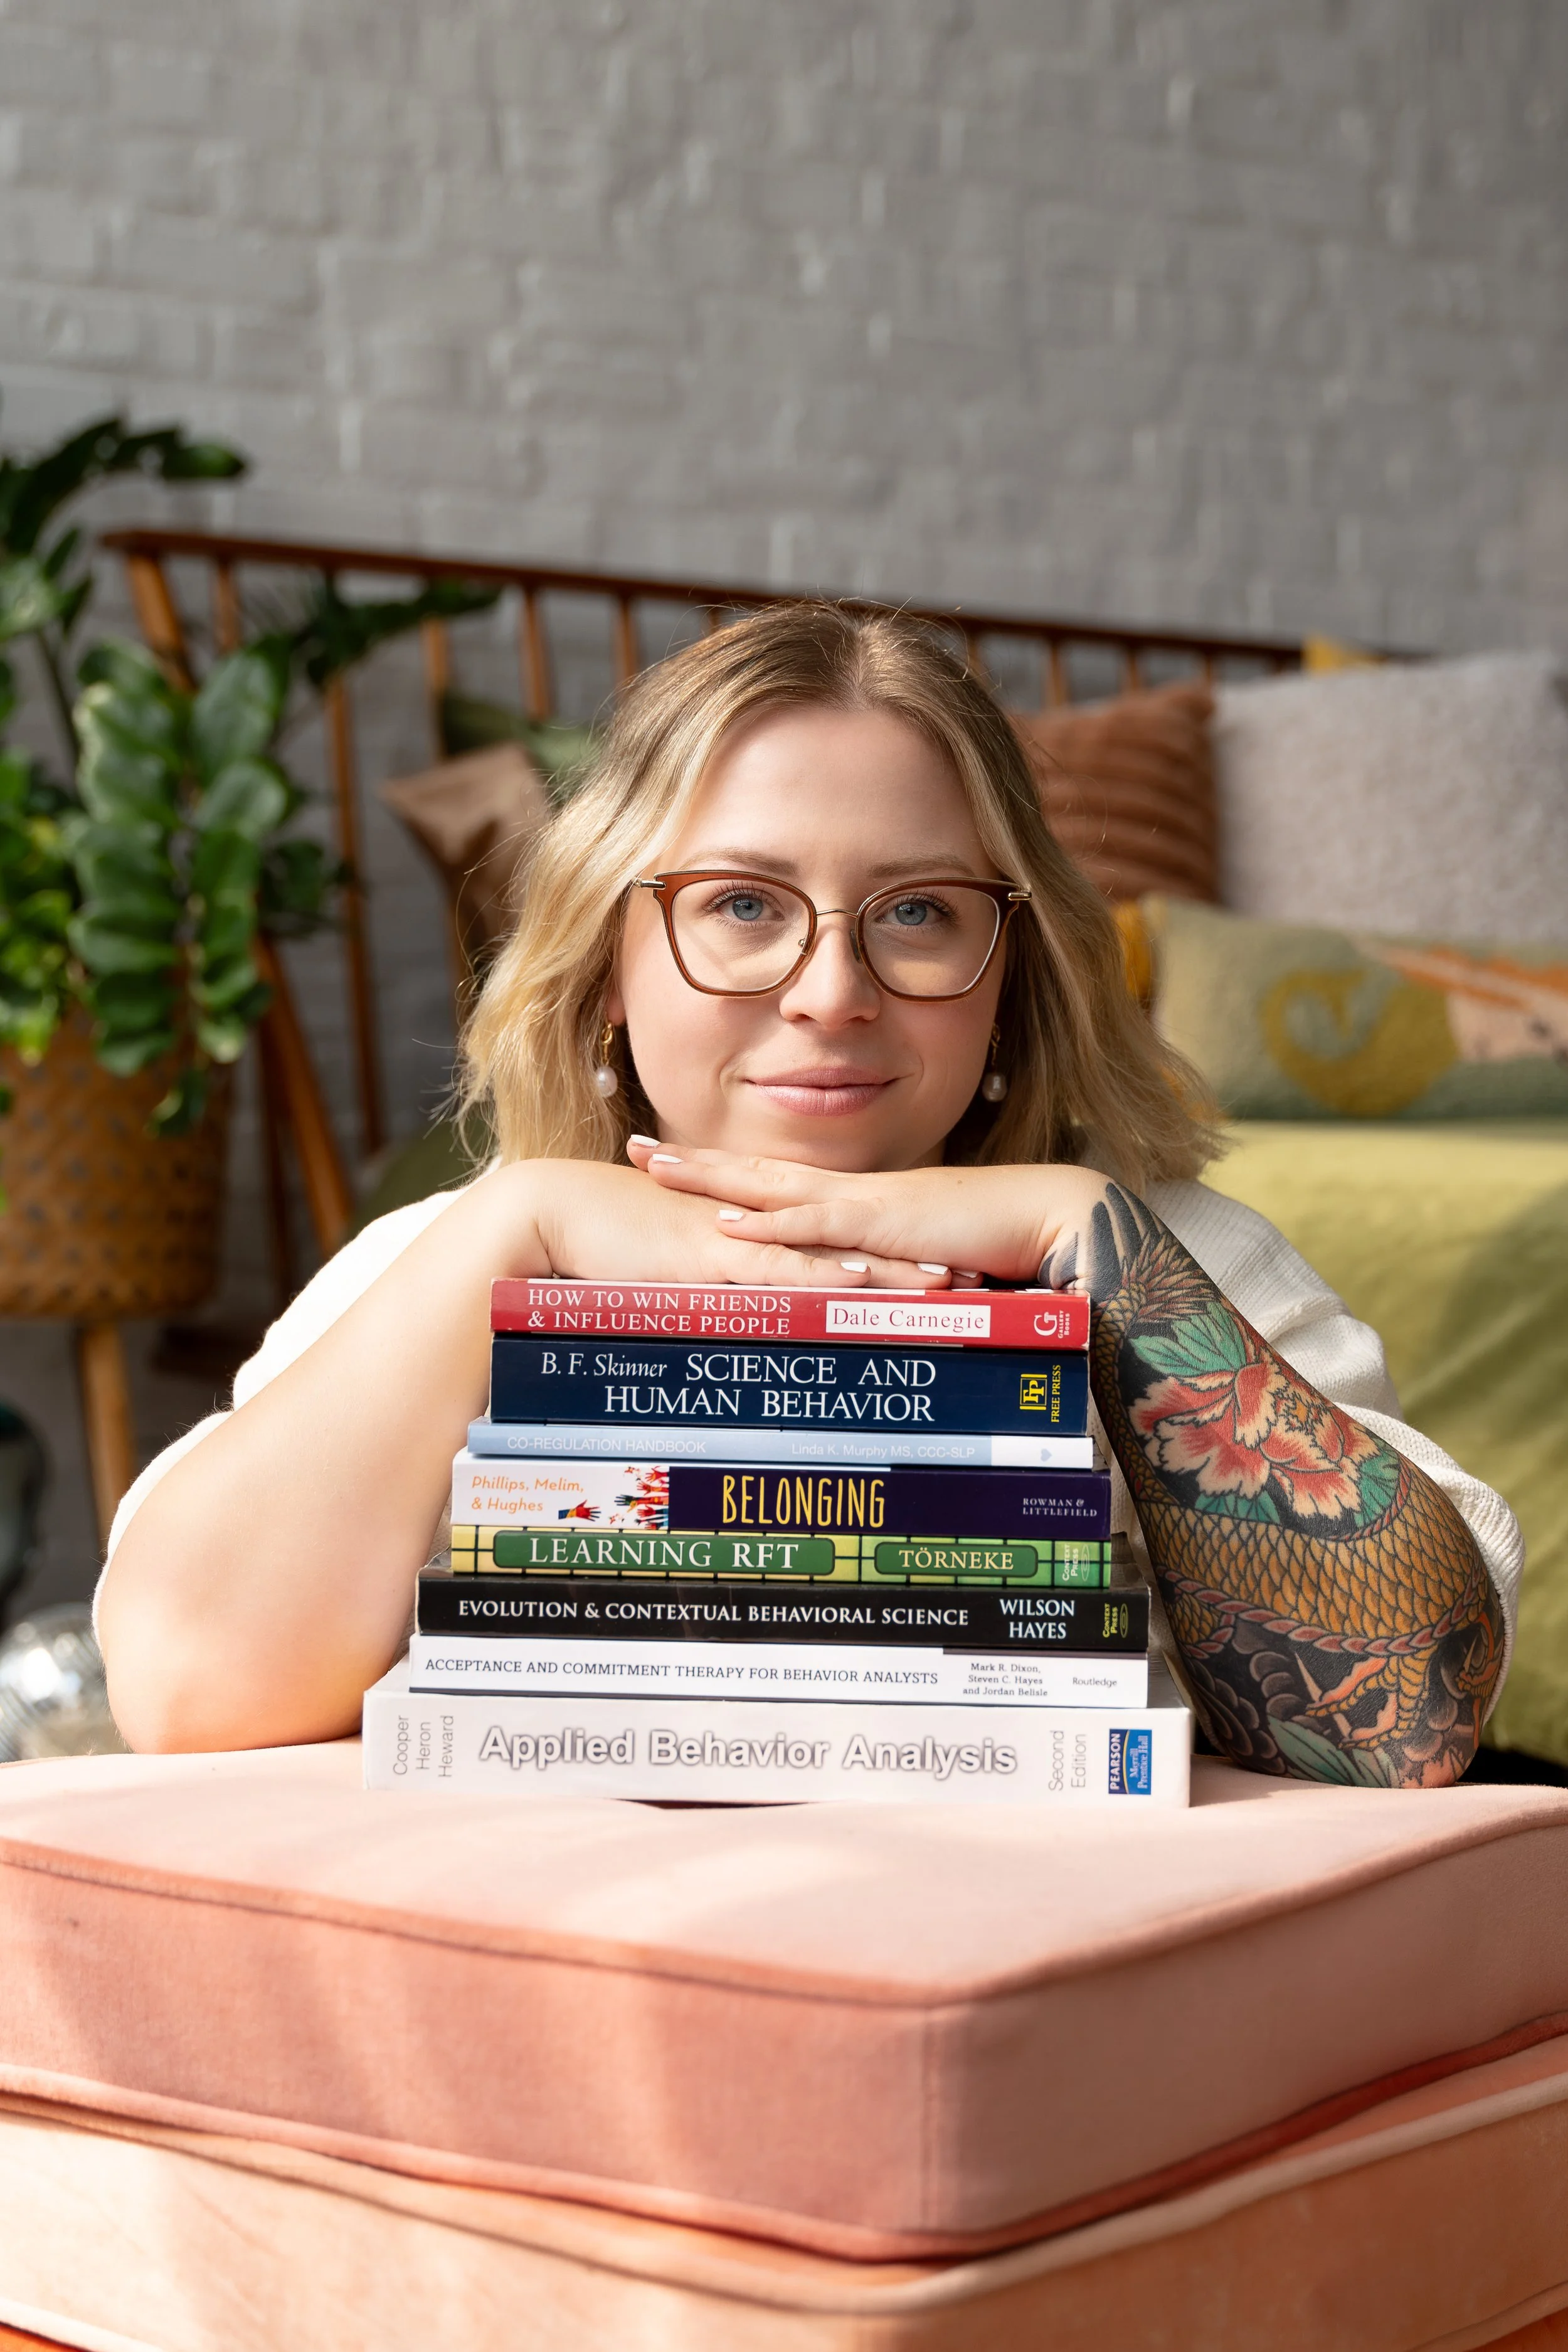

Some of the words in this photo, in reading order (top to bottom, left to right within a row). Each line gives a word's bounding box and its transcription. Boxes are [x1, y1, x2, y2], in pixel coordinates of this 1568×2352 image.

[528, 1290, 584, 1306] HOW
[593, 1291, 623, 1308] TO
[633, 1292, 678, 1309] WIN
[689, 1293, 791, 1313] FRIENDS
[528, 1311, 545, 1327] &
[554, 1312, 691, 1331] INFLUENCE
[701, 1316, 790, 1335] PEOPLE
[834, 1308, 879, 1326] Dale
[889, 1310, 983, 1333] Carnegie
[541, 1353, 560, 1374] B.
[568, 1353, 586, 1375] F.
[594, 1353, 667, 1377] Skinner
[686, 1353, 837, 1384] SCIENCE
[858, 1359, 936, 1387] AND
[1052, 1365, 1061, 1395] PRESS
[605, 1385, 741, 1416] HUMAN
[761, 1390, 935, 1421] BEHAVIOR
[1051, 1397, 1060, 1422] FREE
[508, 1437, 620, 1451] CO-REGULATION
[627, 1441, 706, 1453] HANDBOOK
[792, 1443, 825, 1455] Linda
[828, 1444, 839, 1456] K.
[844, 1445, 887, 1459] Murphy
[891, 1446, 914, 1458] MS,
[918, 1446, 975, 1458] CCC-SLP
[472, 1476, 529, 1492] Phillips,
[534, 1478, 584, 1493] Melim,
[471, 1498, 482, 1510] &
[487, 1497, 543, 1515] Hughes
[723, 1475, 884, 1528] BELONGING
[1022, 1507, 1097, 1517] LITTLEFIELD
[1023, 1498, 1073, 1506] ROWMAN
[1076, 1498, 1084, 1507] &
[530, 1538, 711, 1567] LEARNING
[732, 1542, 798, 1569] RFT
[899, 1547, 1014, 1570] TÖRNEKE
[458, 1600, 577, 1618] EVOLUTION
[585, 1603, 600, 1619] &
[606, 1603, 741, 1621] CONTEXTUAL
[749, 1606, 875, 1624] BEHAVIORAL
[882, 1608, 969, 1625] SCIENCE
[1000, 1599, 1075, 1617] WILSON
[1009, 1622, 1066, 1639] HAYES
[425, 1659, 521, 1672] ACCEPTANCE
[527, 1662, 558, 1673] AND
[563, 1663, 670, 1677] COMMITMENT
[677, 1666, 744, 1679] THERAPY
[750, 1668, 778, 1680] FOR
[784, 1669, 858, 1682] BEHAVIOR
[863, 1670, 938, 1685] ANALYSTS
[968, 1675, 999, 1683] Steven
[1002, 1676, 1011, 1684] C.
[1015, 1677, 1042, 1685] Hayes
[971, 1663, 995, 1671] Mark
[999, 1664, 1007, 1672] R.
[1011, 1664, 1041, 1673] Dixon,
[1018, 1688, 1048, 1697] Belisle
[1073, 1677, 1117, 1688] Routledge
[393, 1715, 409, 1776] Cooper
[416, 1721, 431, 1769] Heron
[438, 1715, 453, 1777] Heward
[479, 1726, 634, 1771] Applied
[649, 1729, 830, 1768] Behavior
[842, 1734, 1018, 1781] Analysis
[1049, 1730, 1064, 1791] Second
[1071, 1734, 1086, 1788] Edition
[1110, 1734, 1120, 1789] PEARSON
